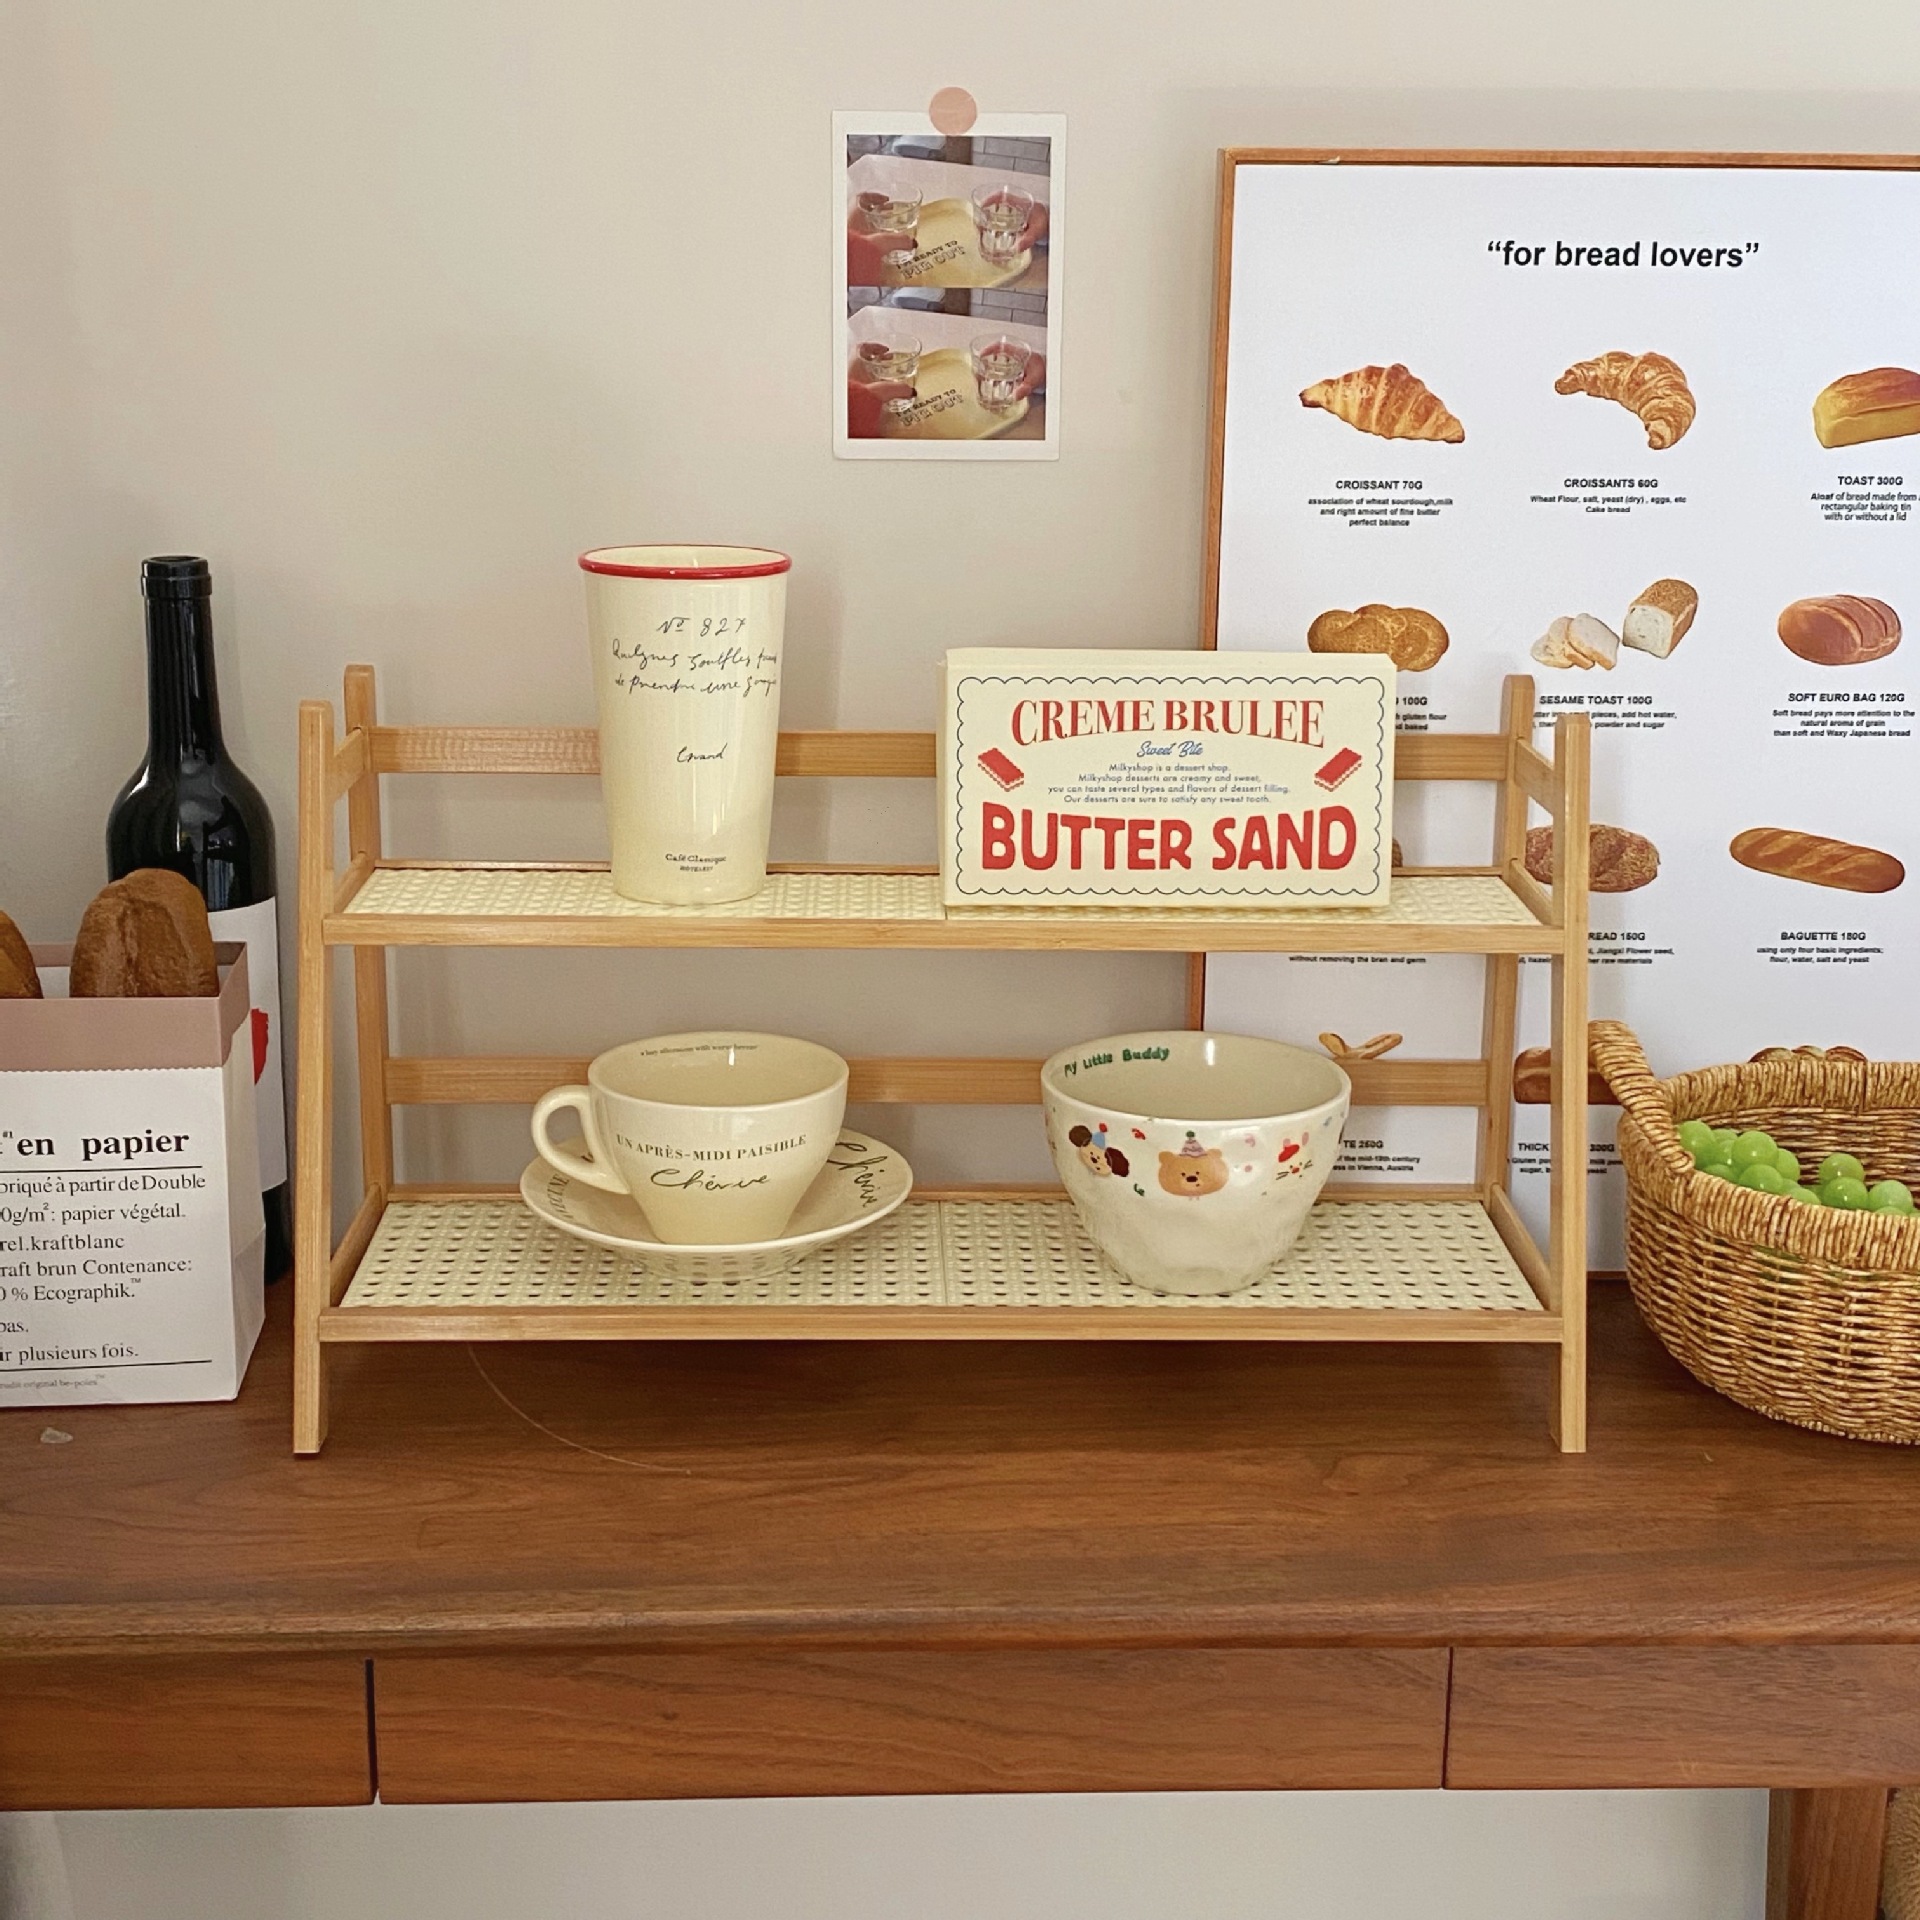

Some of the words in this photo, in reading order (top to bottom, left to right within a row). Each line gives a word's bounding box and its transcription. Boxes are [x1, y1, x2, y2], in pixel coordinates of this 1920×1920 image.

[1554, 241, 1640, 266] bread
[1336, 480, 1400, 490] CROISSANT
[1402, 480, 1422, 490] 70G
[1564, 479, 1635, 488] CROISSANTS
[1838, 476, 1875, 485] TOAST
[1877, 476, 1903, 486] 300G
[1602, 496, 1624, 504] yeast
[1846, 492, 1870, 500] bread
[1872, 492, 1896, 500] made
[1897, 492, 1917, 500] from
[1820, 502, 1868, 512] rectangular
[1870, 502, 1898, 512] baking
[1824, 512, 1842, 520] with
[1856, 512, 1887, 520] without
[1896, 512, 1907, 520] lid
[1403, 696, 1428, 705] 100G
[1540, 696, 1584, 705] SESAME
[1588, 696, 1624, 705] TOAST
[1628, 696, 1653, 705] 100G
[1788, 693, 1817, 702] SOFT
[1819, 693, 1850, 702] EURO
[1853, 693, 1876, 702] BAG
[1012, 700, 1155, 746] CREME
[1162, 700, 1324, 748] BRULEE
[1137, 740, 1173, 758] Sweet
[1178, 740, 1203, 757] Bite
[1109, 763, 1153, 773] Milkyshop
[1174, 763, 1205, 771] dessert
[1078, 774, 1122, 783] Milkyshop
[1048, 786, 1064, 794] you
[1109, 784, 1139, 792] several
[1142, 785, 1165, 794] types
[1187, 784, 1216, 792] flavors
[1064, 795, 1081, 803] Our
[1084, 795, 1118, 803] desserts
[1171, 794, 1197, 804] satisfy
[982, 801, 1192, 870] BUTTER
[1212, 805, 1357, 870] SAND
[1588, 932, 1617, 940] READ
[1781, 932, 1838, 940] BAGUETTE
[1122, 1046, 1170, 1061] Buddy
[17, 1138, 54, 1156] en
[81, 1129, 189, 1162] papier
[616, 1134, 632, 1149] UN
[636, 1145, 731, 1161] APRÈS-MIDI
[737, 1134, 806, 1159] PAISIBLE
[56, 1176, 65, 1192] à
[69, 1176, 115, 1196] partir
[118, 1176, 139, 1190] de
[142, 1174, 206, 1190] Double
[61, 1205, 115, 1225] papier
[120, 1203, 186, 1223] végétal.
[37, 1261, 77, 1277] brun
[83, 1259, 192, 1274] Contenance:
[19, 1346, 97, 1365] plusieurs
[102, 1343, 138, 1358] fois.
